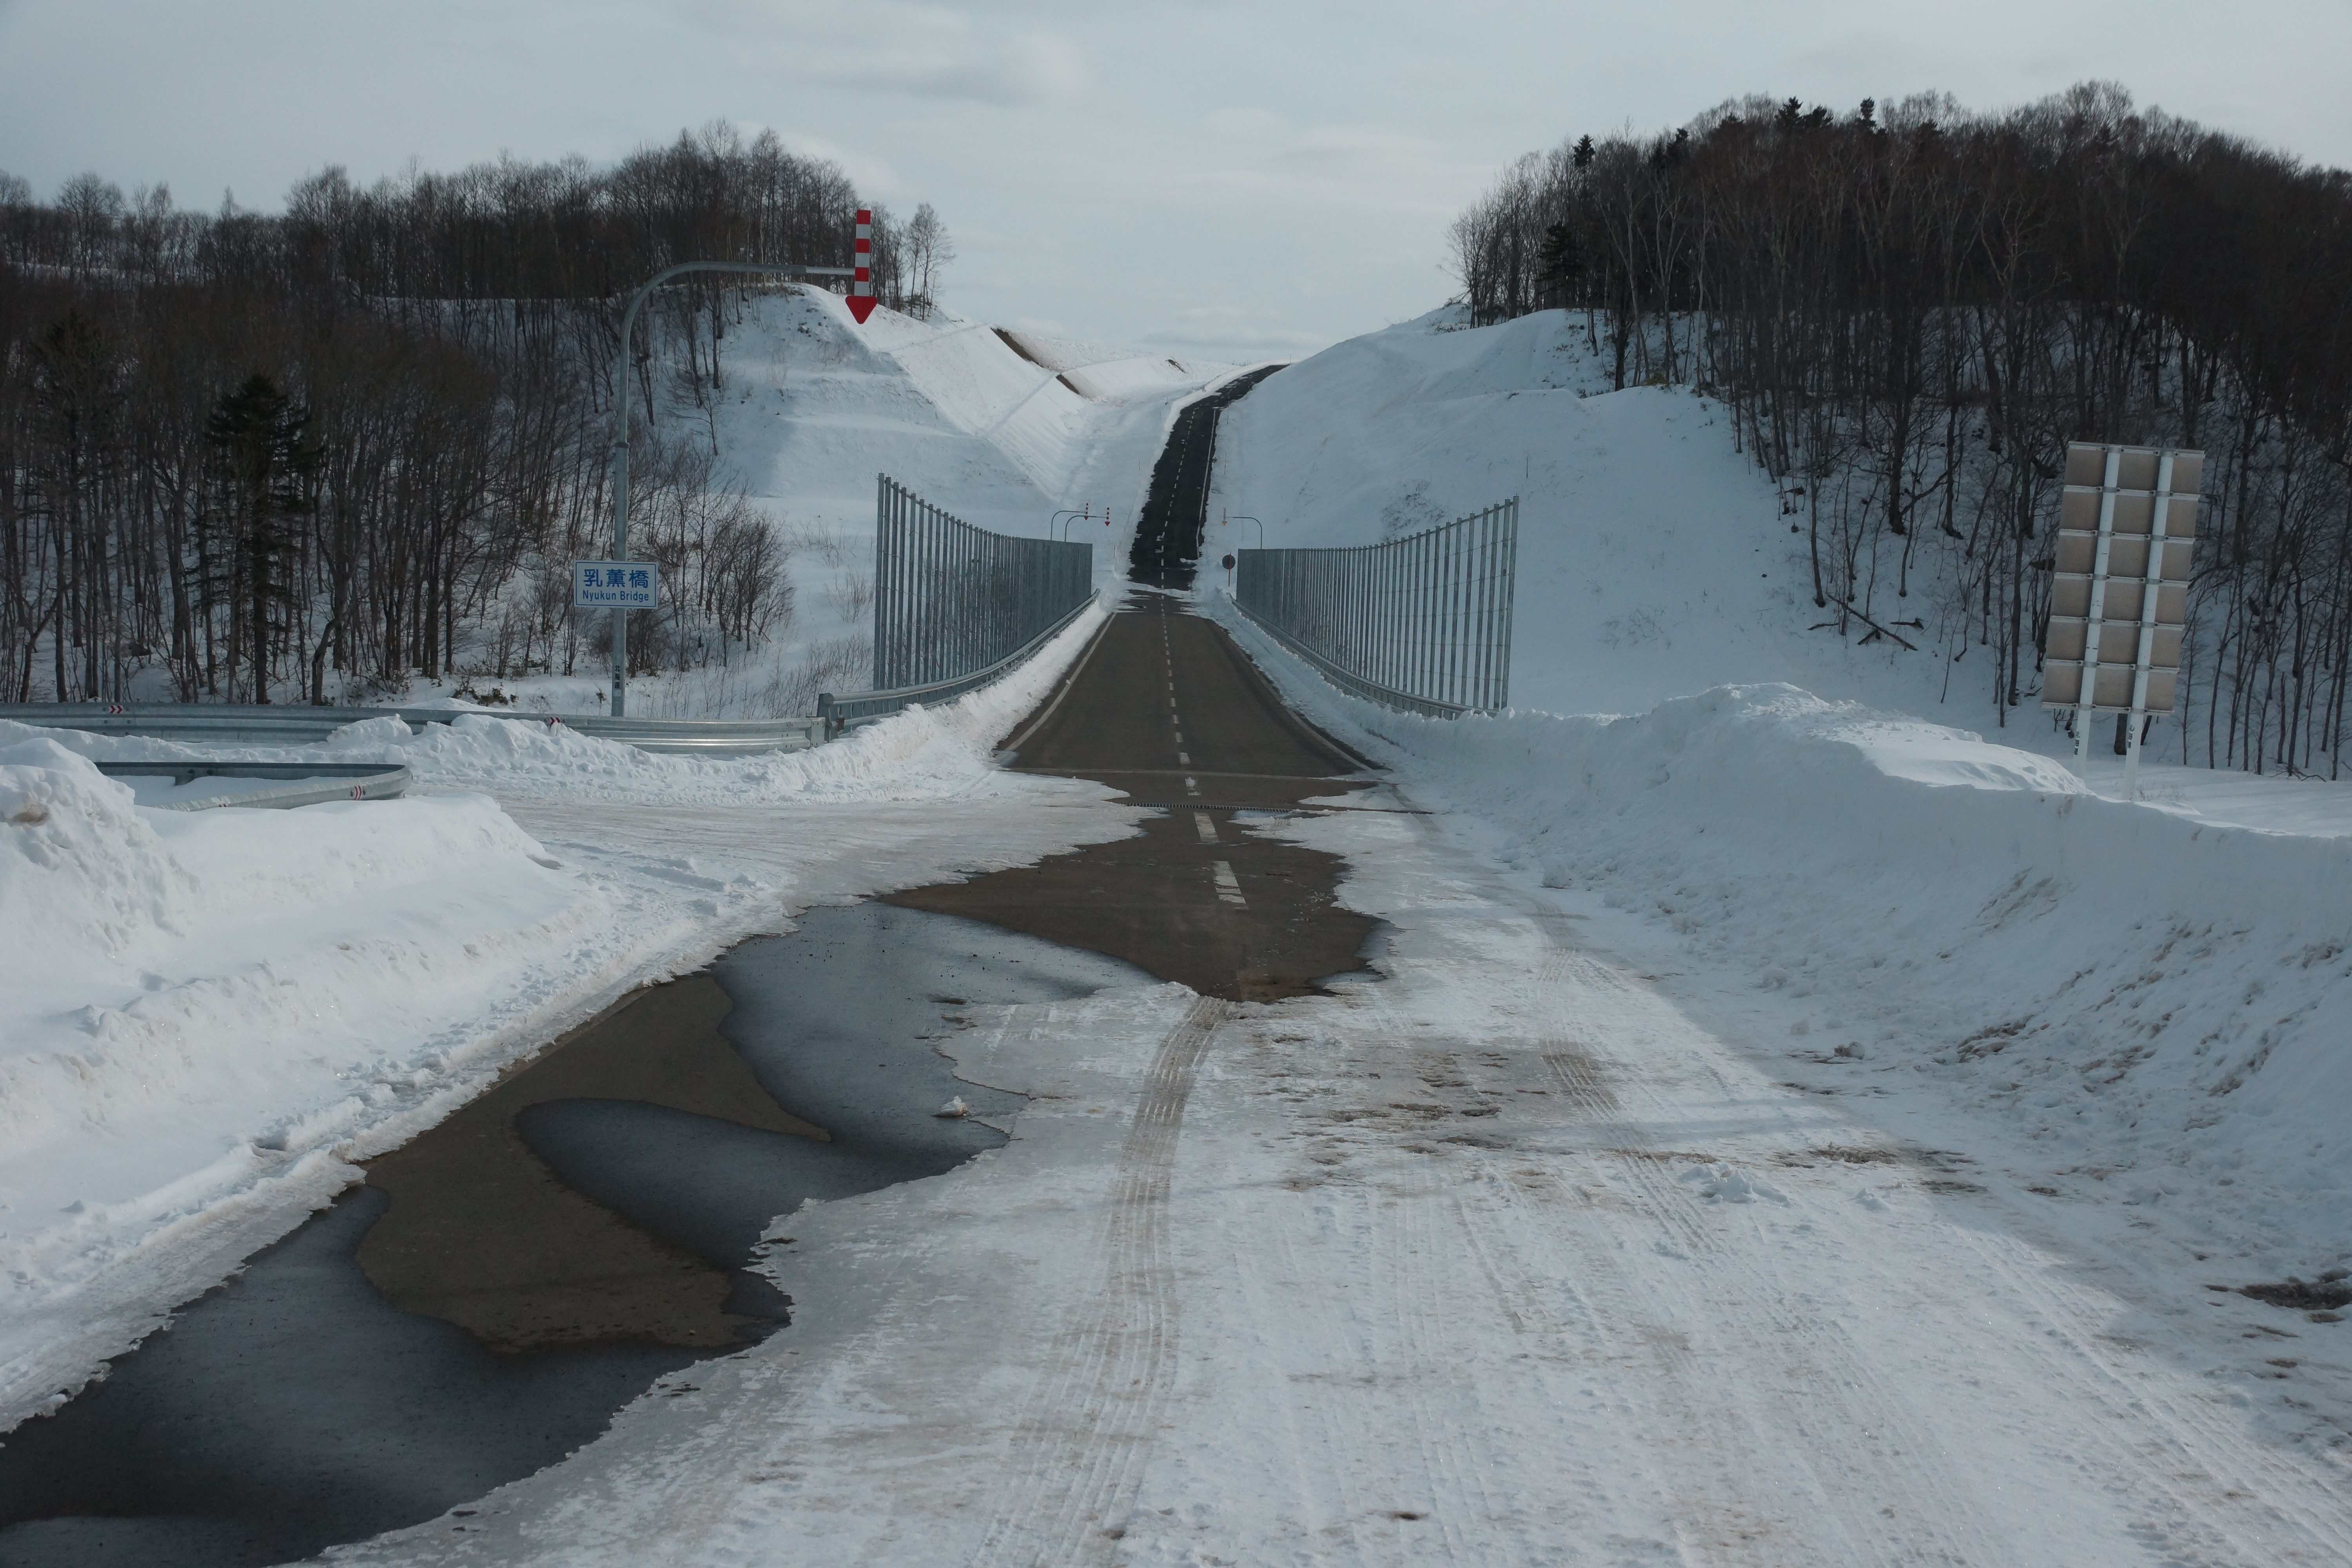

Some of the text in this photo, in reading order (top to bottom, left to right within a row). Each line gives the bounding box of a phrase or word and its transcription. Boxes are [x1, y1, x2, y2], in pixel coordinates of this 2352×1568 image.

[583, 569, 649, 588] 乳薫橋
[583, 590, 649, 603] Nyukun Bridge
